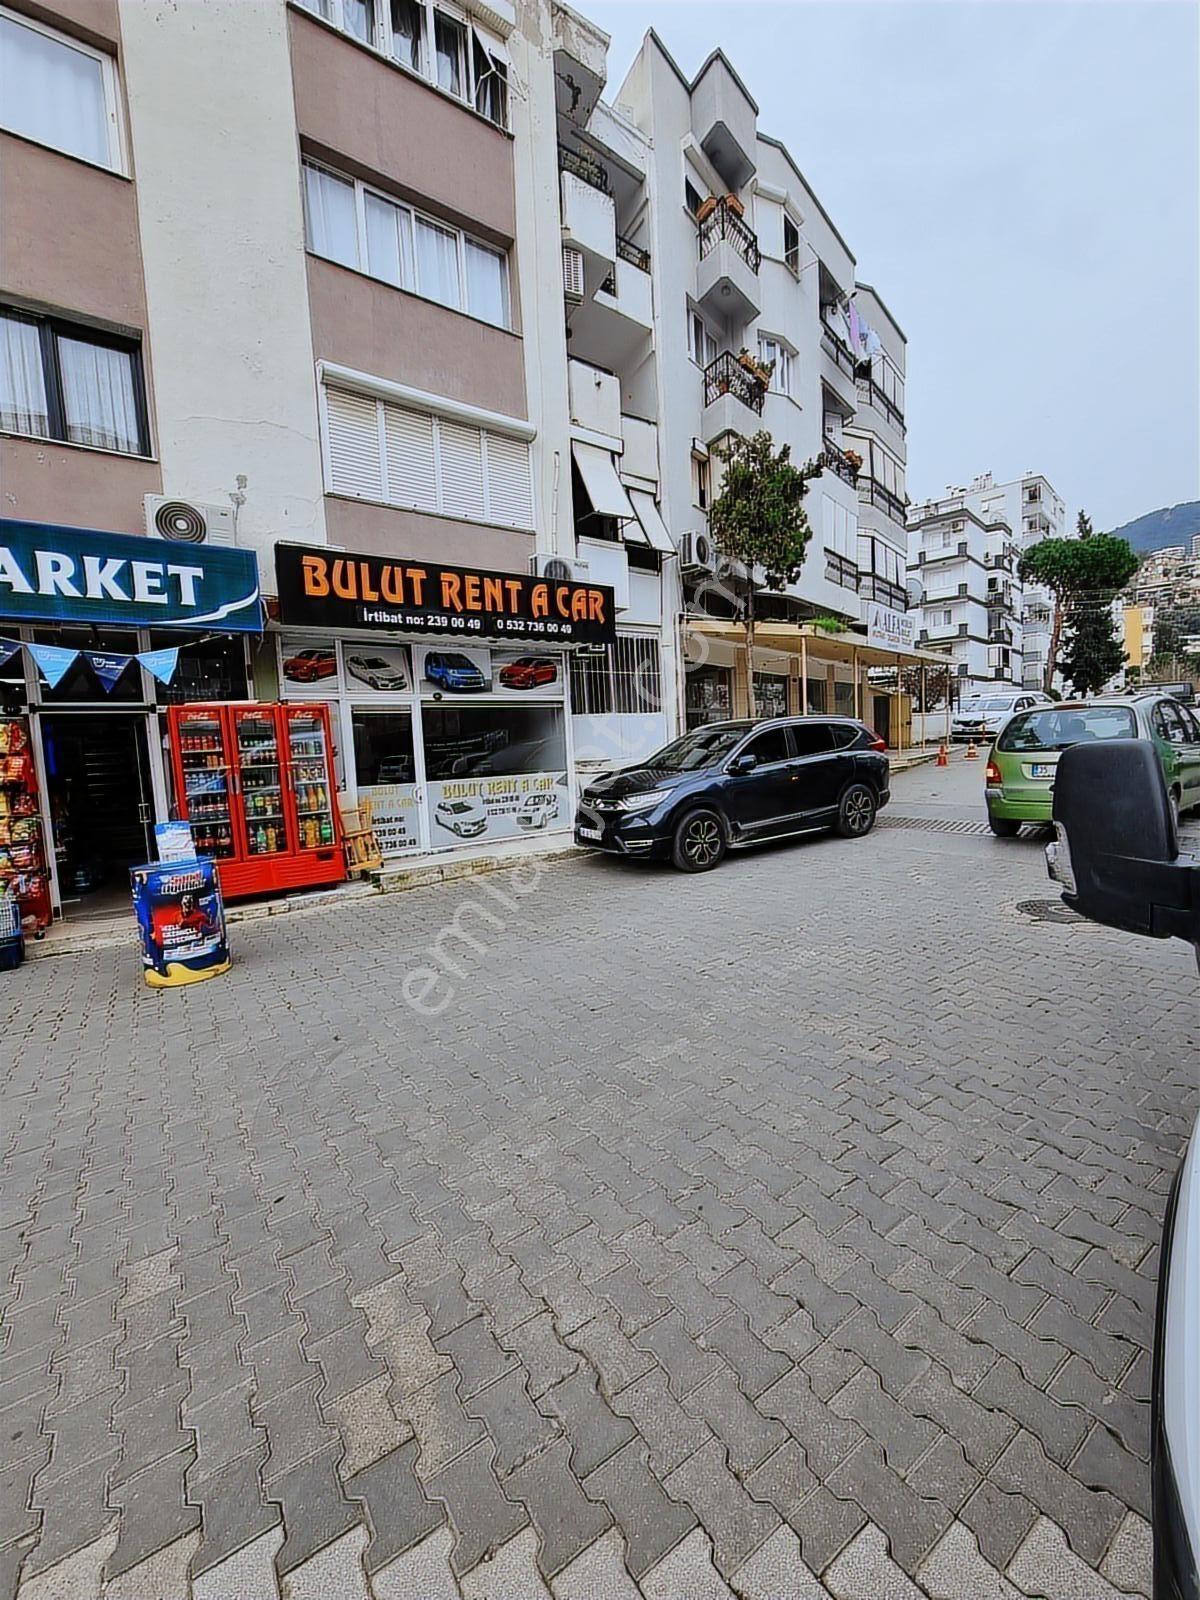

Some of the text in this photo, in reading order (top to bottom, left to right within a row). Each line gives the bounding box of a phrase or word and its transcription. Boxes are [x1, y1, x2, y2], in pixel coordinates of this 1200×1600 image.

[302, 555, 606, 624] BULUT RENT A CAR
[406, 616, 425, 626] no:
[427, 615, 448, 627] 239
[451, 617, 465, 628] 00
[467, 618, 481, 630] 49
[497, 619, 573, 634] 0 532 736 00 49
